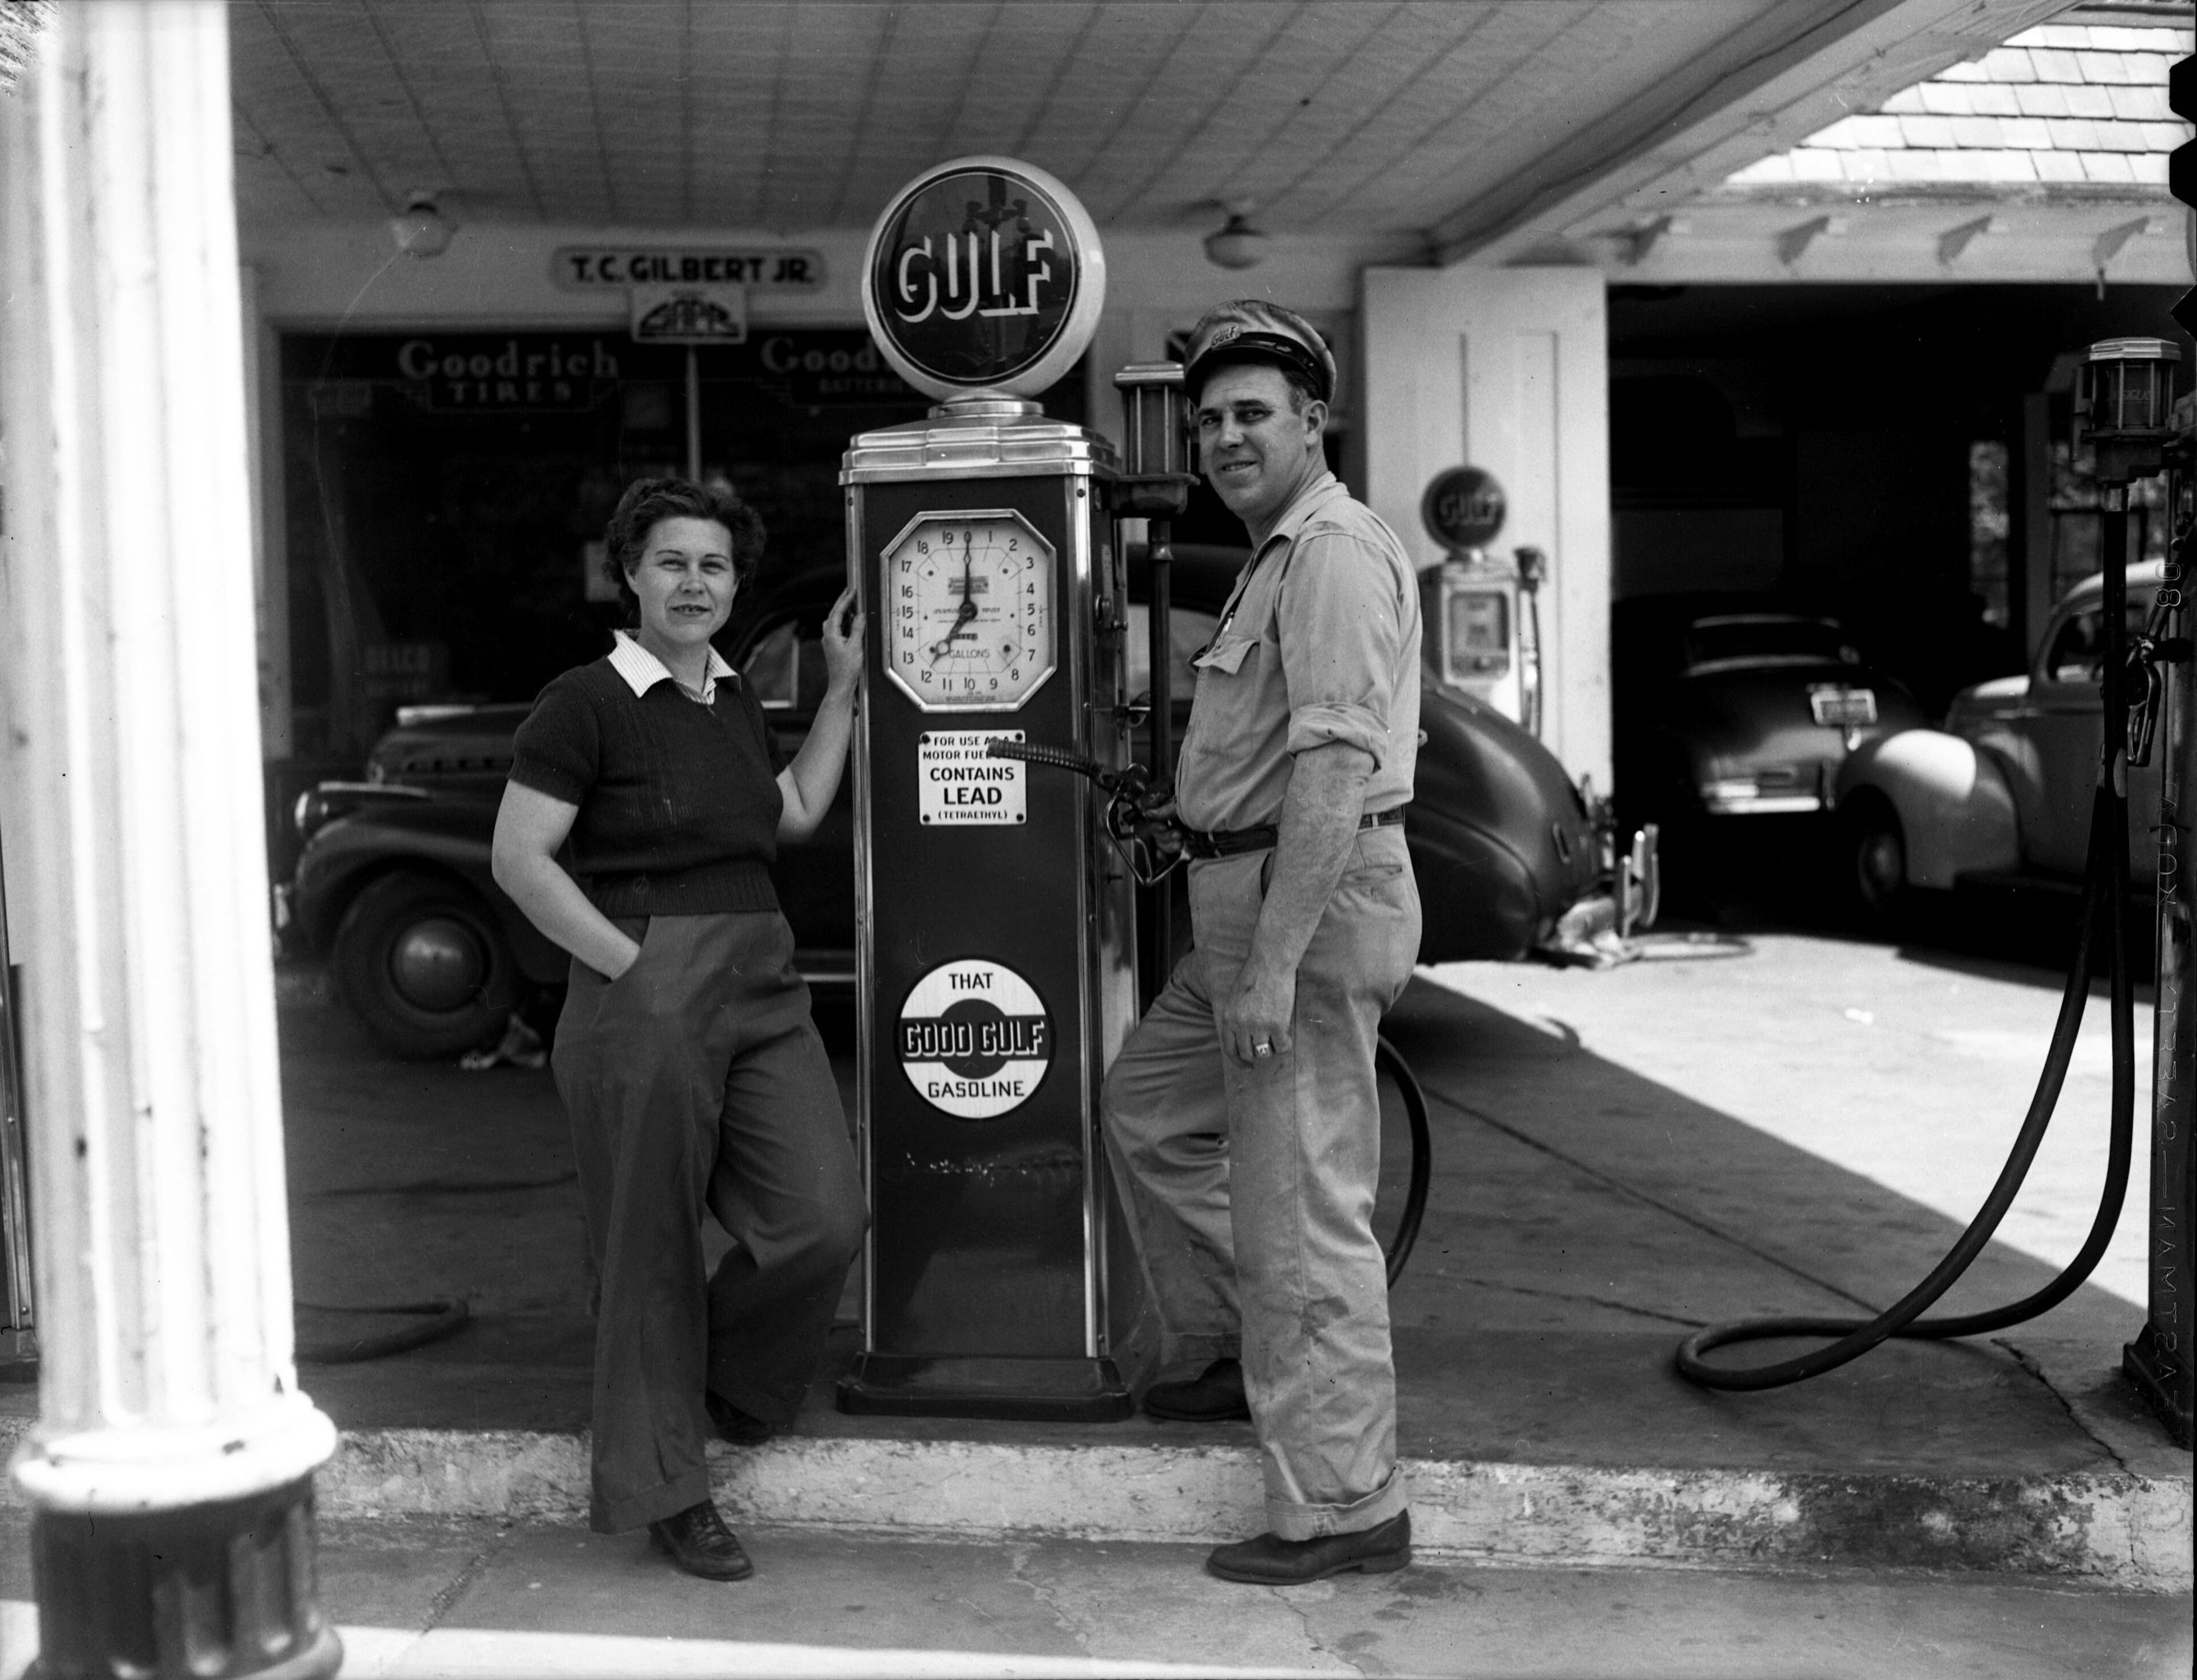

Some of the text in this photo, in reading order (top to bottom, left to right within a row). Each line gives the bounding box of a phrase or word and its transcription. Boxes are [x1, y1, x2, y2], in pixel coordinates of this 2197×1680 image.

[630, 256, 765, 282] GILBERT
[889, 228, 1054, 323] GULF
[396, 339, 618, 380] Goodrich
[760, 335, 894, 374] Good
[445, 380, 573, 403] TIRES
[942, 532, 954, 545] 19
[988, 530, 993, 542] 1
[917, 540, 929, 554] 18
[1009, 539, 1018, 552] 2
[902, 560, 912, 573] 17
[1026, 557, 1034, 570] 3
[902, 585, 913, 599] 16
[1026, 583, 1034, 595] 4
[902, 606, 914, 619] 15
[1028, 604, 1035, 616] 5
[903, 627, 914, 639] 14
[1027, 625, 1036, 636] 6
[903, 651, 914, 664] 13
[949, 649, 990, 658] GALLONS
[1028, 649, 1036, 661] 7
[921, 670, 932, 683] 12
[1011, 669, 1020, 681] 8
[942, 678, 952, 691] 11
[964, 677, 975, 691] 10
[990, 677, 998, 690] 9
[934, 736, 955, 746] FOR
[960, 736, 980, 746] USE
[923, 751, 961, 760] MOTOR
[930, 767, 1014, 781] CONTAINS
[944, 787, 1002, 805] LEAD
[938, 810, 1008, 820] (TETRAETHYL)
[949, 973, 994, 989] THAT
[903, 1020, 1045, 1057] GOOD GULF
[928, 1080, 1025, 1097] GASOLINE
